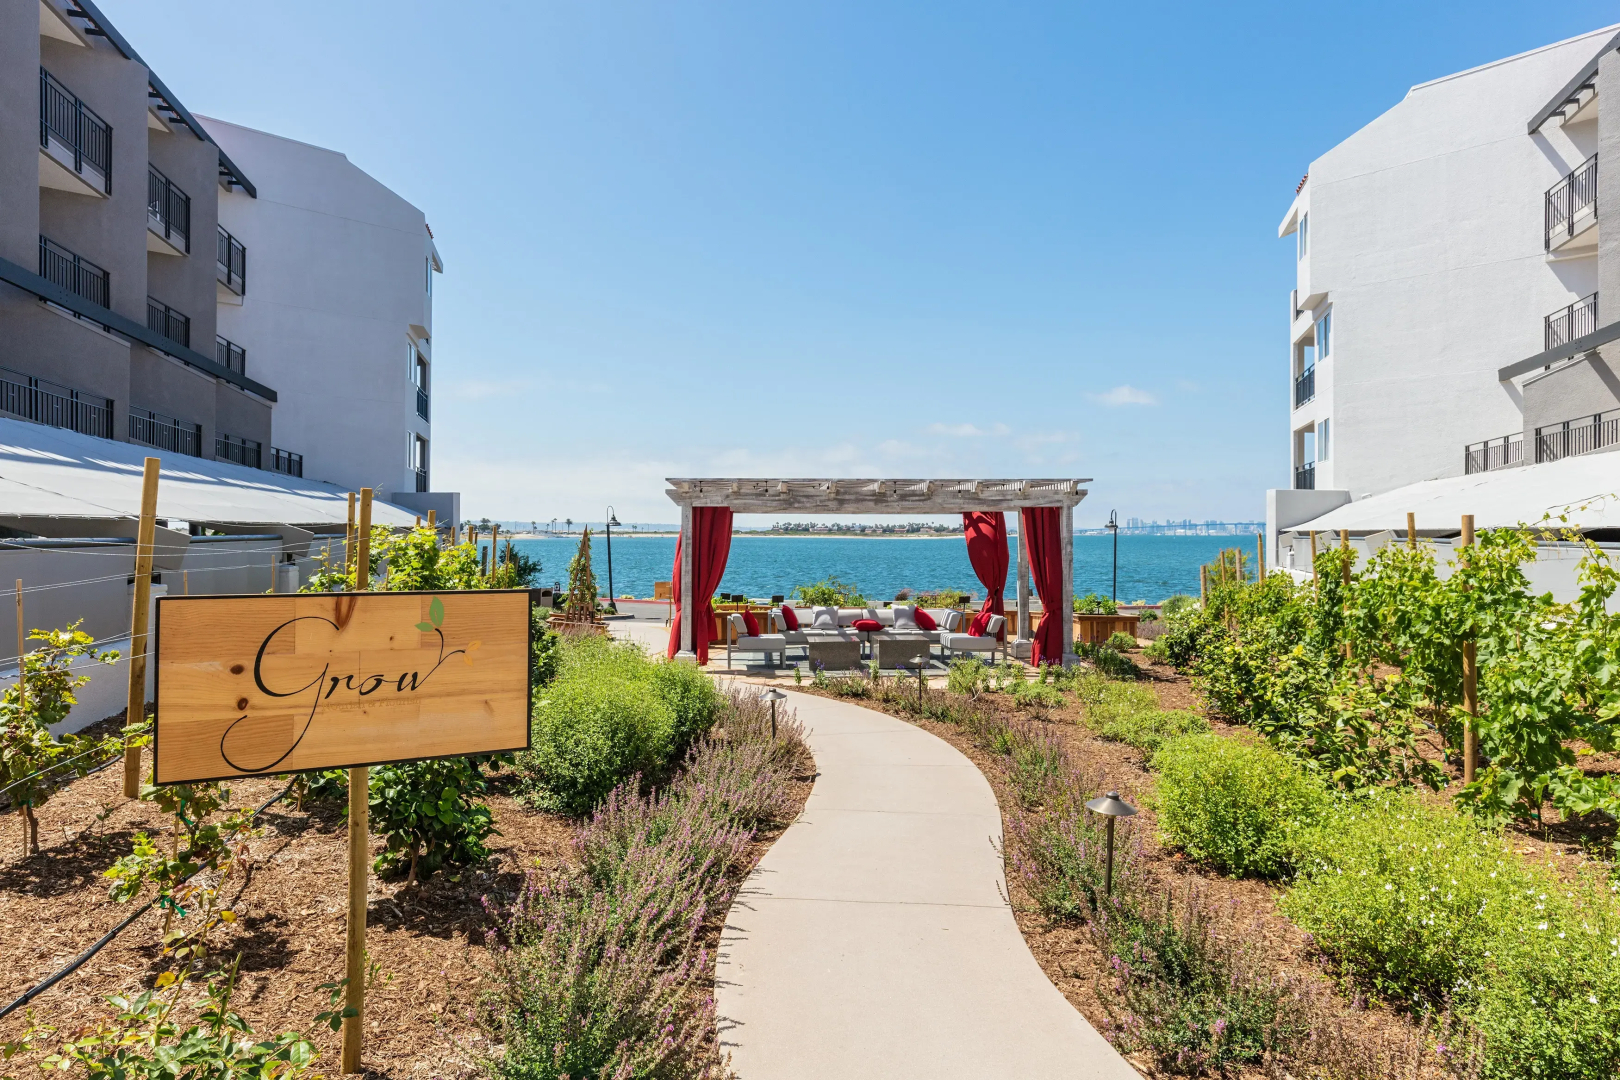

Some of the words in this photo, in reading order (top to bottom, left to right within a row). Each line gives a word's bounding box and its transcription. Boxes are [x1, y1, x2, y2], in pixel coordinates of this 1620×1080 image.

[220, 616, 465, 773] Grow
[368, 699, 376, 708] &
[379, 697, 421, 708] Flourish
